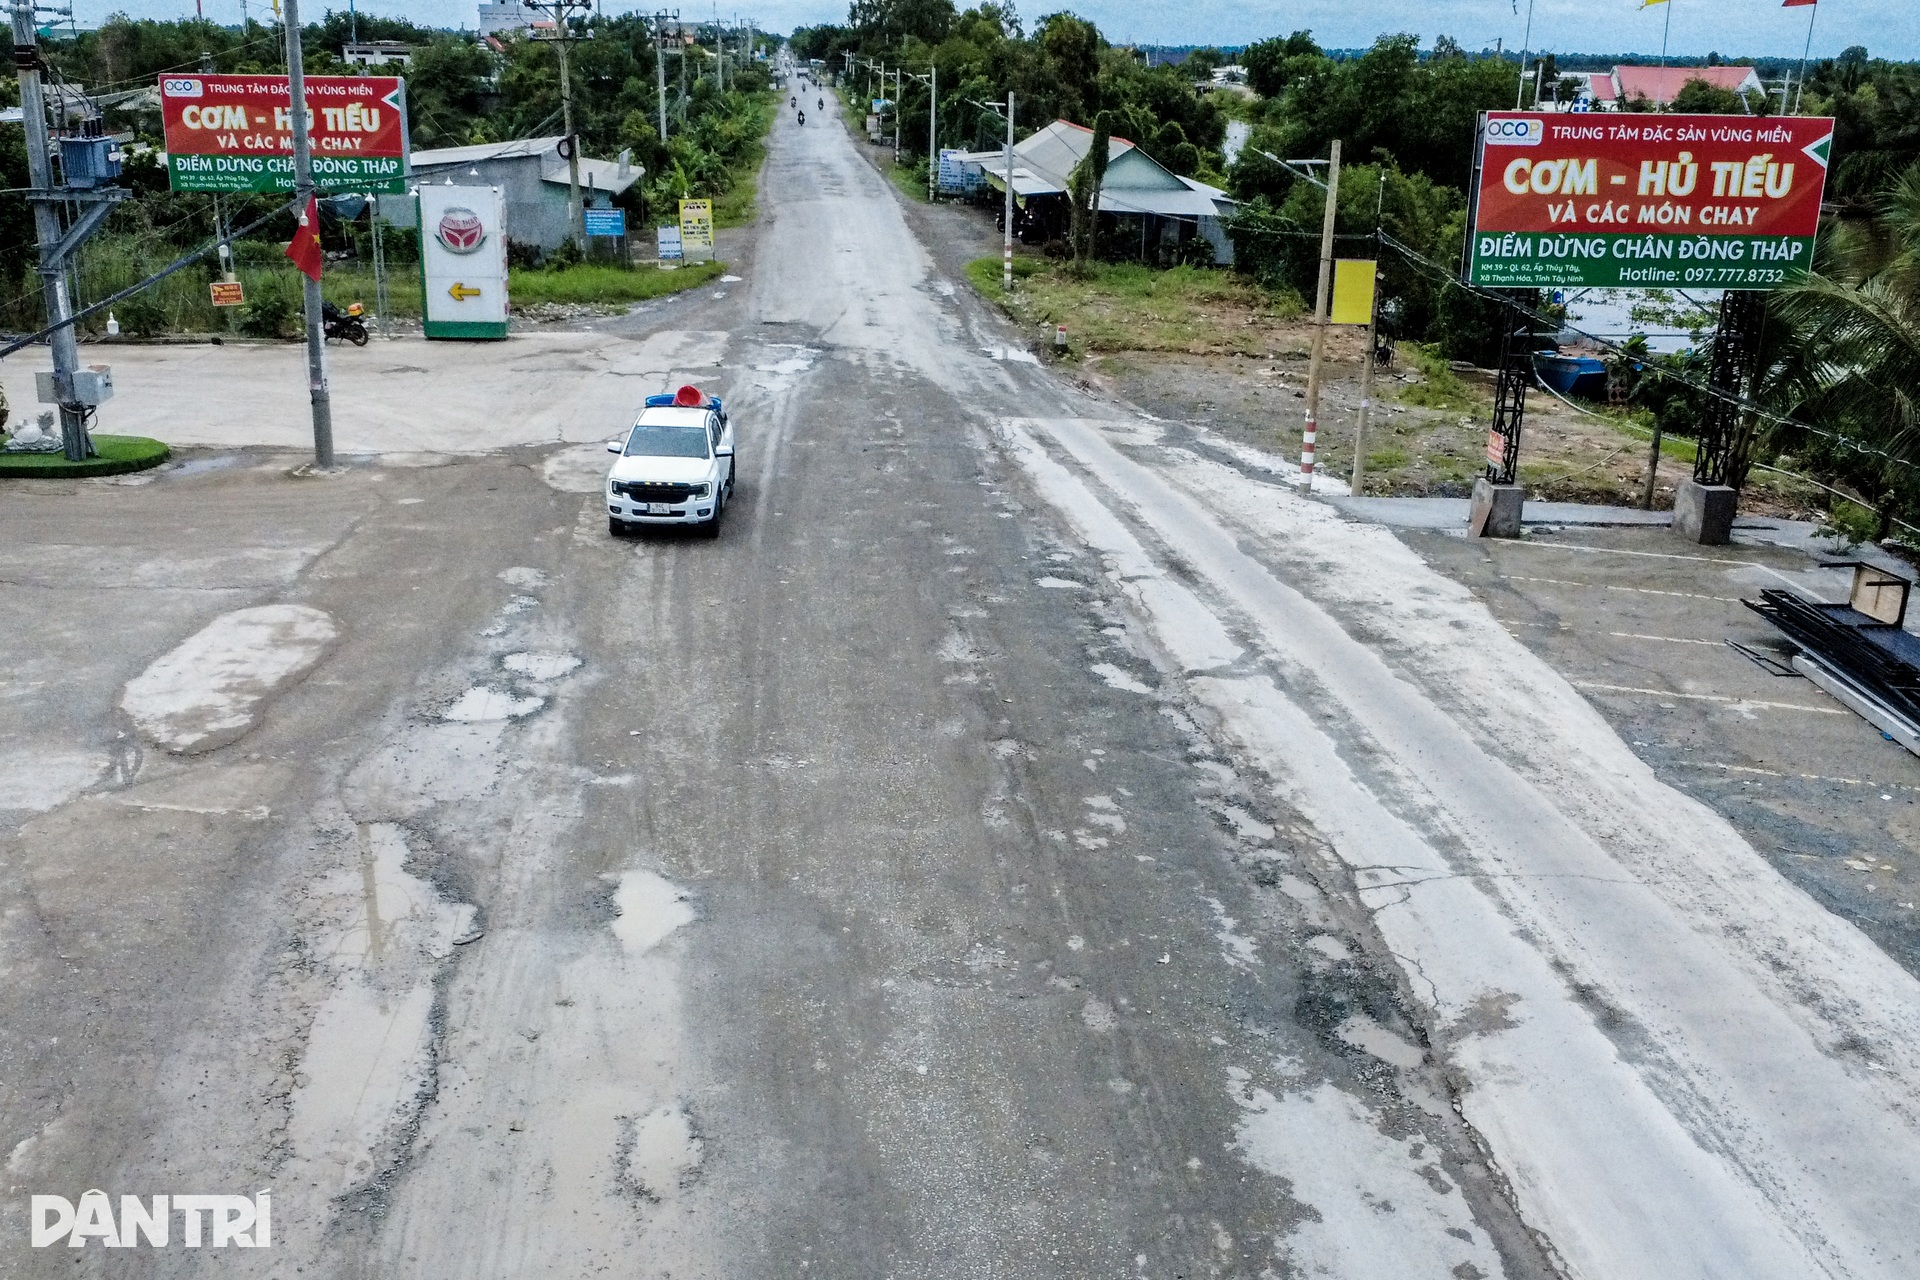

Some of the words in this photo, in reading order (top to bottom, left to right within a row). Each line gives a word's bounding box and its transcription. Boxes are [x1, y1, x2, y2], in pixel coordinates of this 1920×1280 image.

[165, 81, 200, 91] OCOP
[208, 84, 244, 94] TRUNG
[246, 83, 268, 94] TÂM
[316, 84, 346, 95] VÙNG
[348, 83, 373, 96] MIỀN
[182, 105, 249, 130] CƠM
[321, 102, 380, 133] TIẾU
[1488, 121, 1540, 136] OCOP
[1552, 126, 1603, 140] TRUNG
[1608, 124, 1639, 140] TÂM
[1642, 124, 1674, 143] ĐẶC
[1676, 124, 1706, 142] SẢN
[1711, 126, 1752, 142] VÙNG
[1756, 125, 1792, 143] MIỀN
[216, 132, 240, 149] VÀ
[243, 133, 274, 149] CÁC
[280, 135, 317, 150] MN
[321, 137, 362, 150] CHAY
[176, 154, 213, 172] ĐIỂM
[216, 155, 264, 172] DỪNG
[267, 156, 296, 172] CHÂ
[312, 157, 358, 173] ĐỒNG
[361, 157, 398, 174] THÁP
[1503, 157, 1598, 195] CƠM
[1610, 175, 1627, 185] -
[1637, 151, 1699, 197] HỦ
[1710, 153, 1795, 199] TIẾU
[1547, 199, 1577, 223] VÀ
[1585, 200, 1630, 224] CÁC
[1637, 200, 1691, 224] MÓN
[1699, 206, 1759, 225] CHAY
[1479, 231, 1532, 257] ĐIỂM
[1538, 234, 1607, 258] DỪNG
[1612, 234, 1674, 259] CHÂN
[1678, 235, 1745, 260] ĐỒNG
[1751, 236, 1803, 261] THÁP
[1481, 263, 1493, 271] KM
[1509, 264, 1519, 272] QL
[1521, 264, 1532, 272] 62,
[1619, 267, 1680, 281] Hotline:
[1684, 267, 1785, 283] 097.777.8732
[1480, 274, 1490, 282] Xã
[1552, 275, 1566, 284] Tây
[1567, 275, 1584, 283] Ninh
